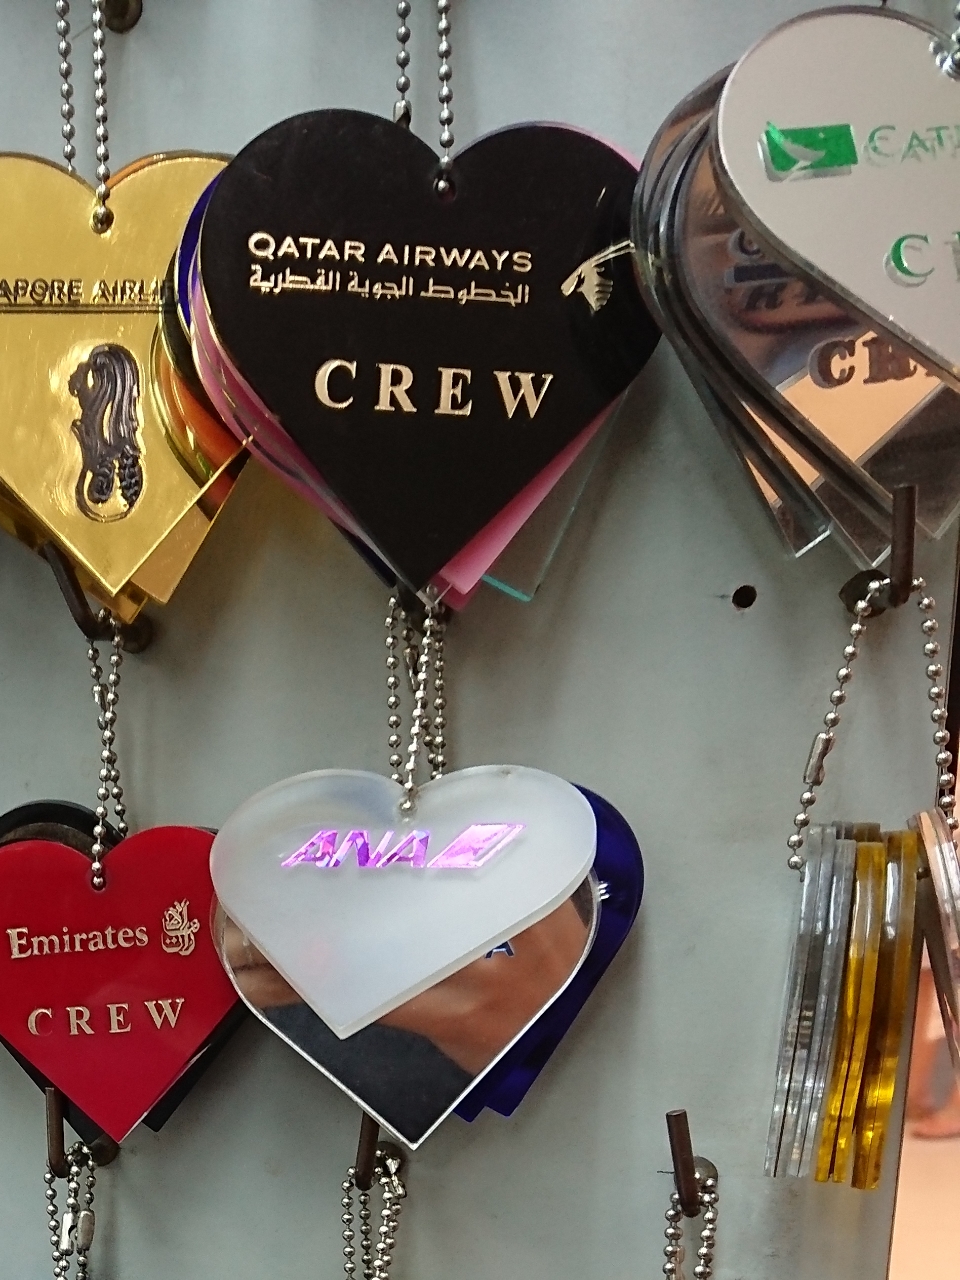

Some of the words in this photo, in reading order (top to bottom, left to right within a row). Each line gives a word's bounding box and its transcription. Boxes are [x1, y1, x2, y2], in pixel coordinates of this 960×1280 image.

[247, 231, 366, 262] QATAR
[376, 242, 532, 273] AIRWAYS
[249, 262, 341, 295] القطرية
[346, 270, 414, 299] الجوية
[419, 277, 530, 307] الخطوط
[313, 358, 555, 420] CREW
[280, 829, 431, 868] ANA
[5, 925, 150, 960] Emirates
[27, 997, 185, 1036] CREW
